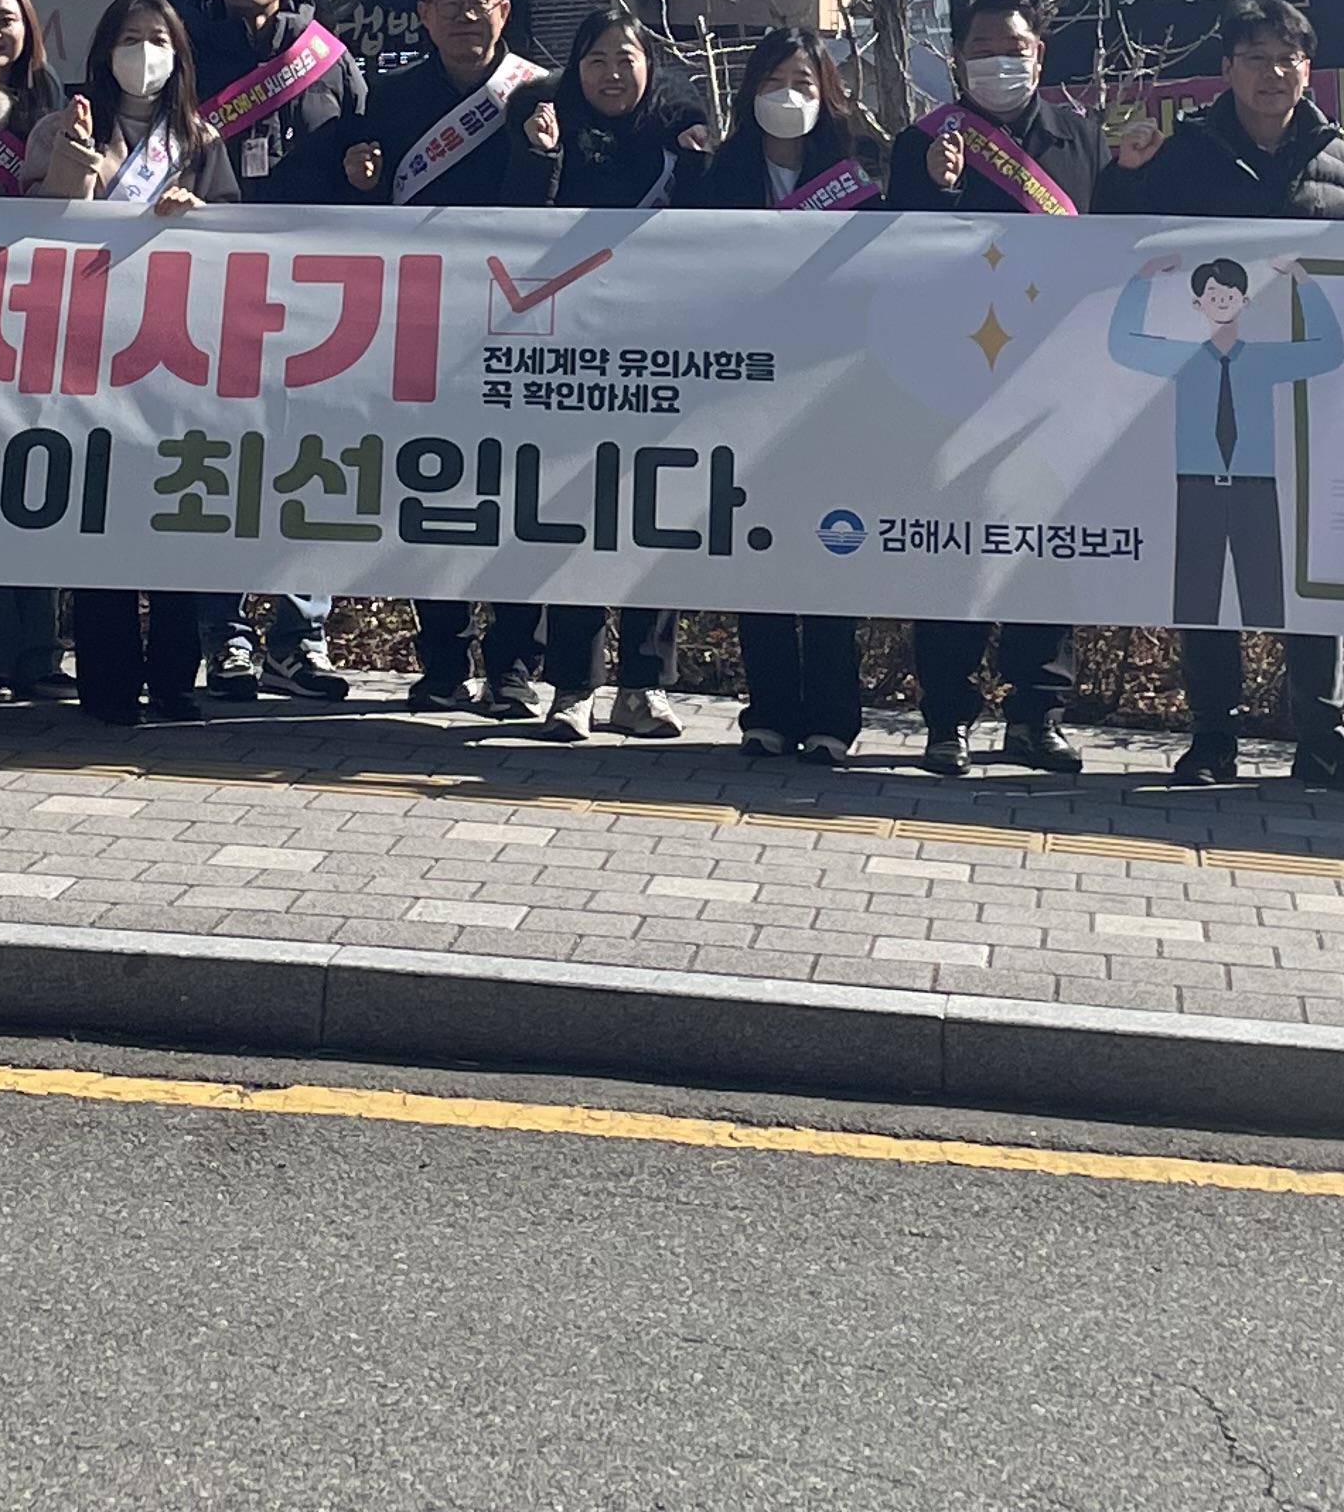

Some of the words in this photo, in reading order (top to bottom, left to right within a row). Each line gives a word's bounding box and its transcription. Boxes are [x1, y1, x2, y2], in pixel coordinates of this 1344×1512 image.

[460, 96, 500, 136] 피해
[425, 125, 464, 163] 예방
[483, 346, 610, 376] 전세계약
[618, 349, 776, 381] 유의사항을
[482, 379, 515, 410] 꼭
[522, 380, 682, 414] 확인하세요
[150, 427, 775, 557] 최선입니다.
[877, 517, 973, 557] 김해시
[980, 519, 1145, 562] 토지정보과
